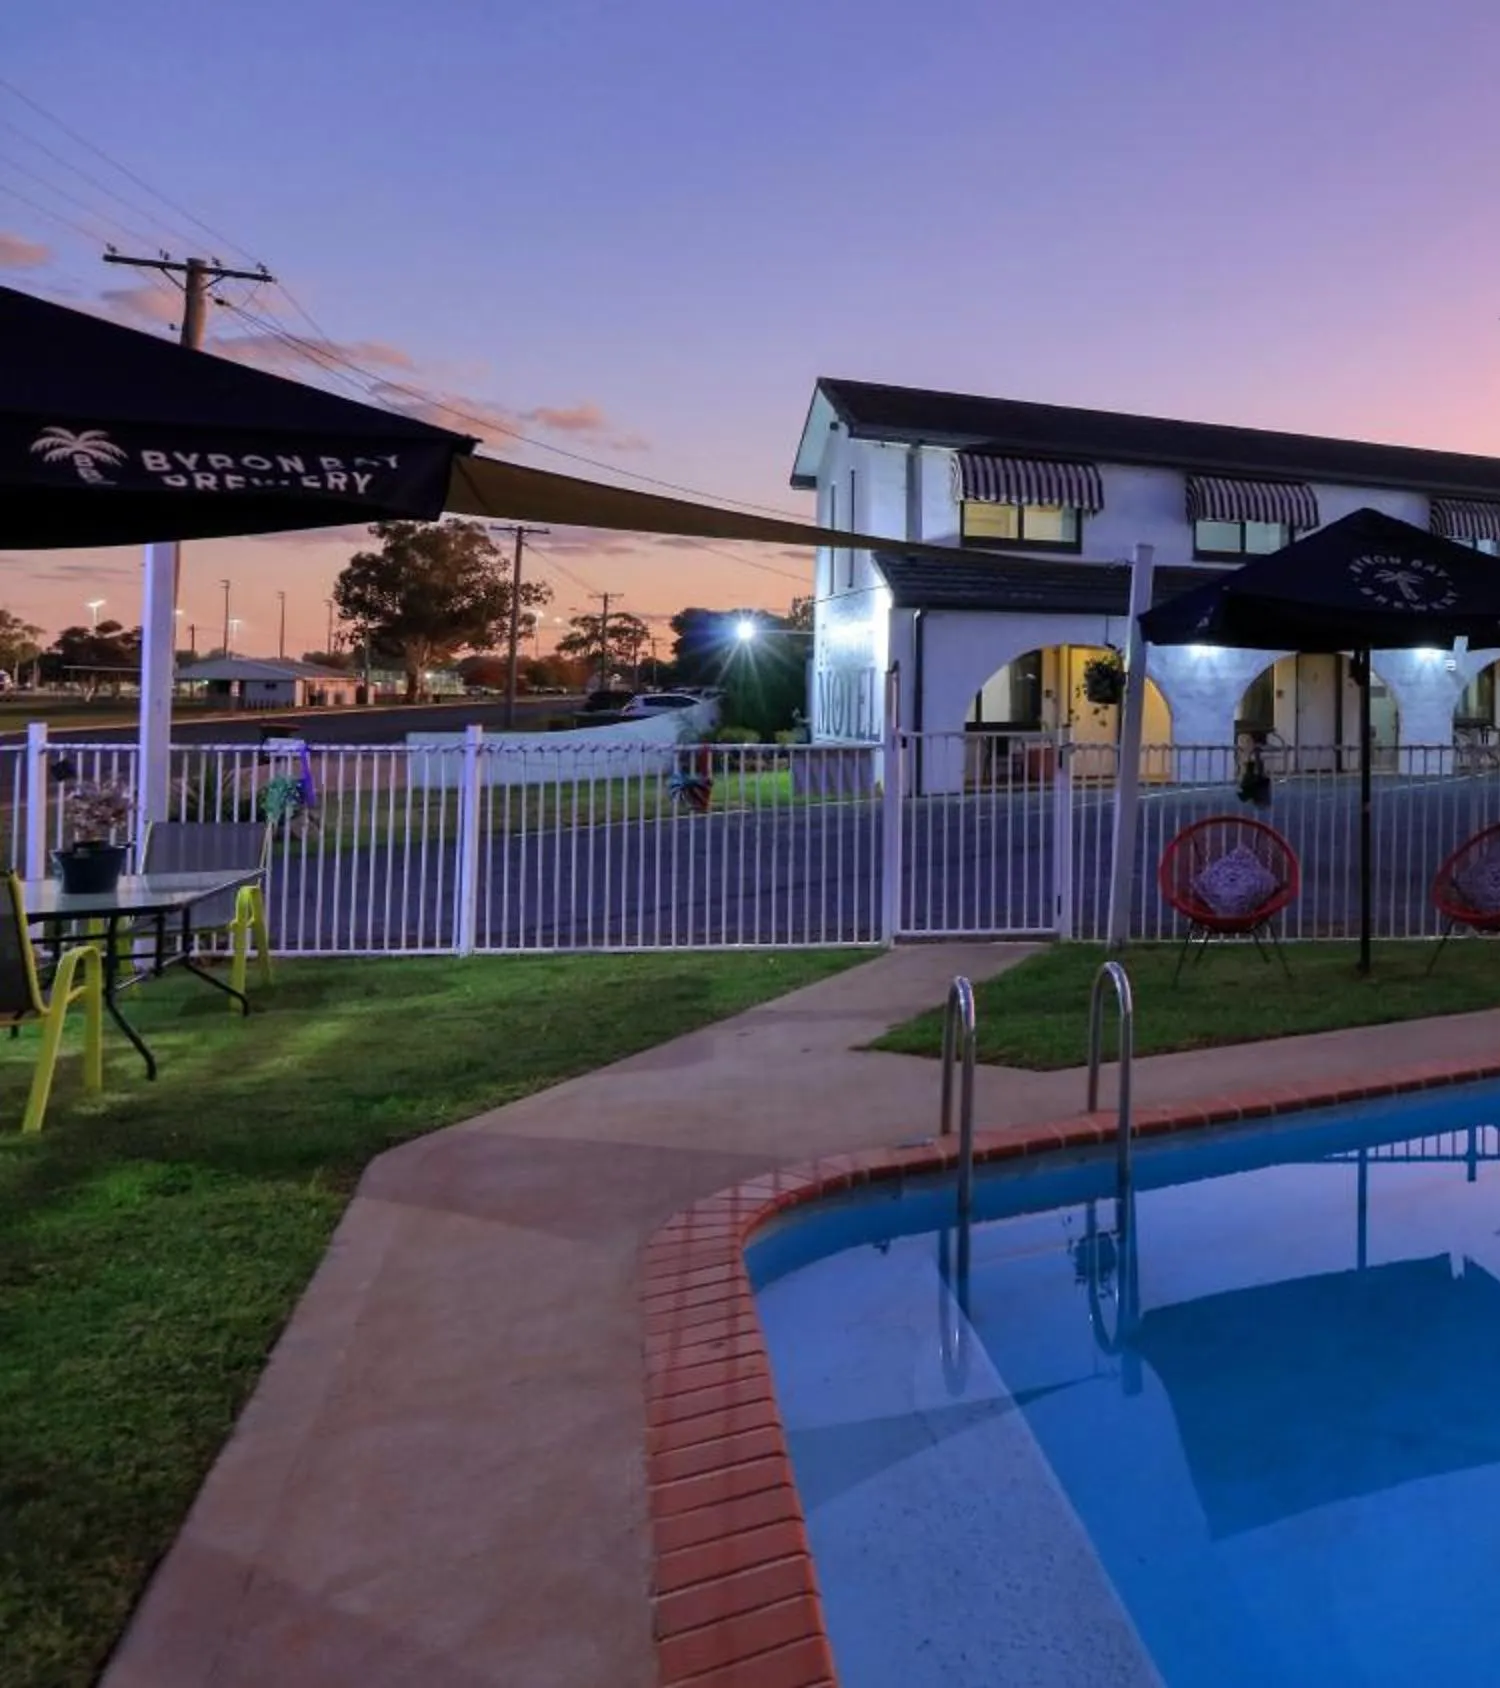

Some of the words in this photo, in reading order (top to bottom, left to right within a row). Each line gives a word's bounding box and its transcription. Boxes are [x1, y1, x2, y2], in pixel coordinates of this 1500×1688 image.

[140, 449, 305, 474] BYRON
[161, 471, 373, 495] BREERY
[817, 667, 881, 742] MOTEL
